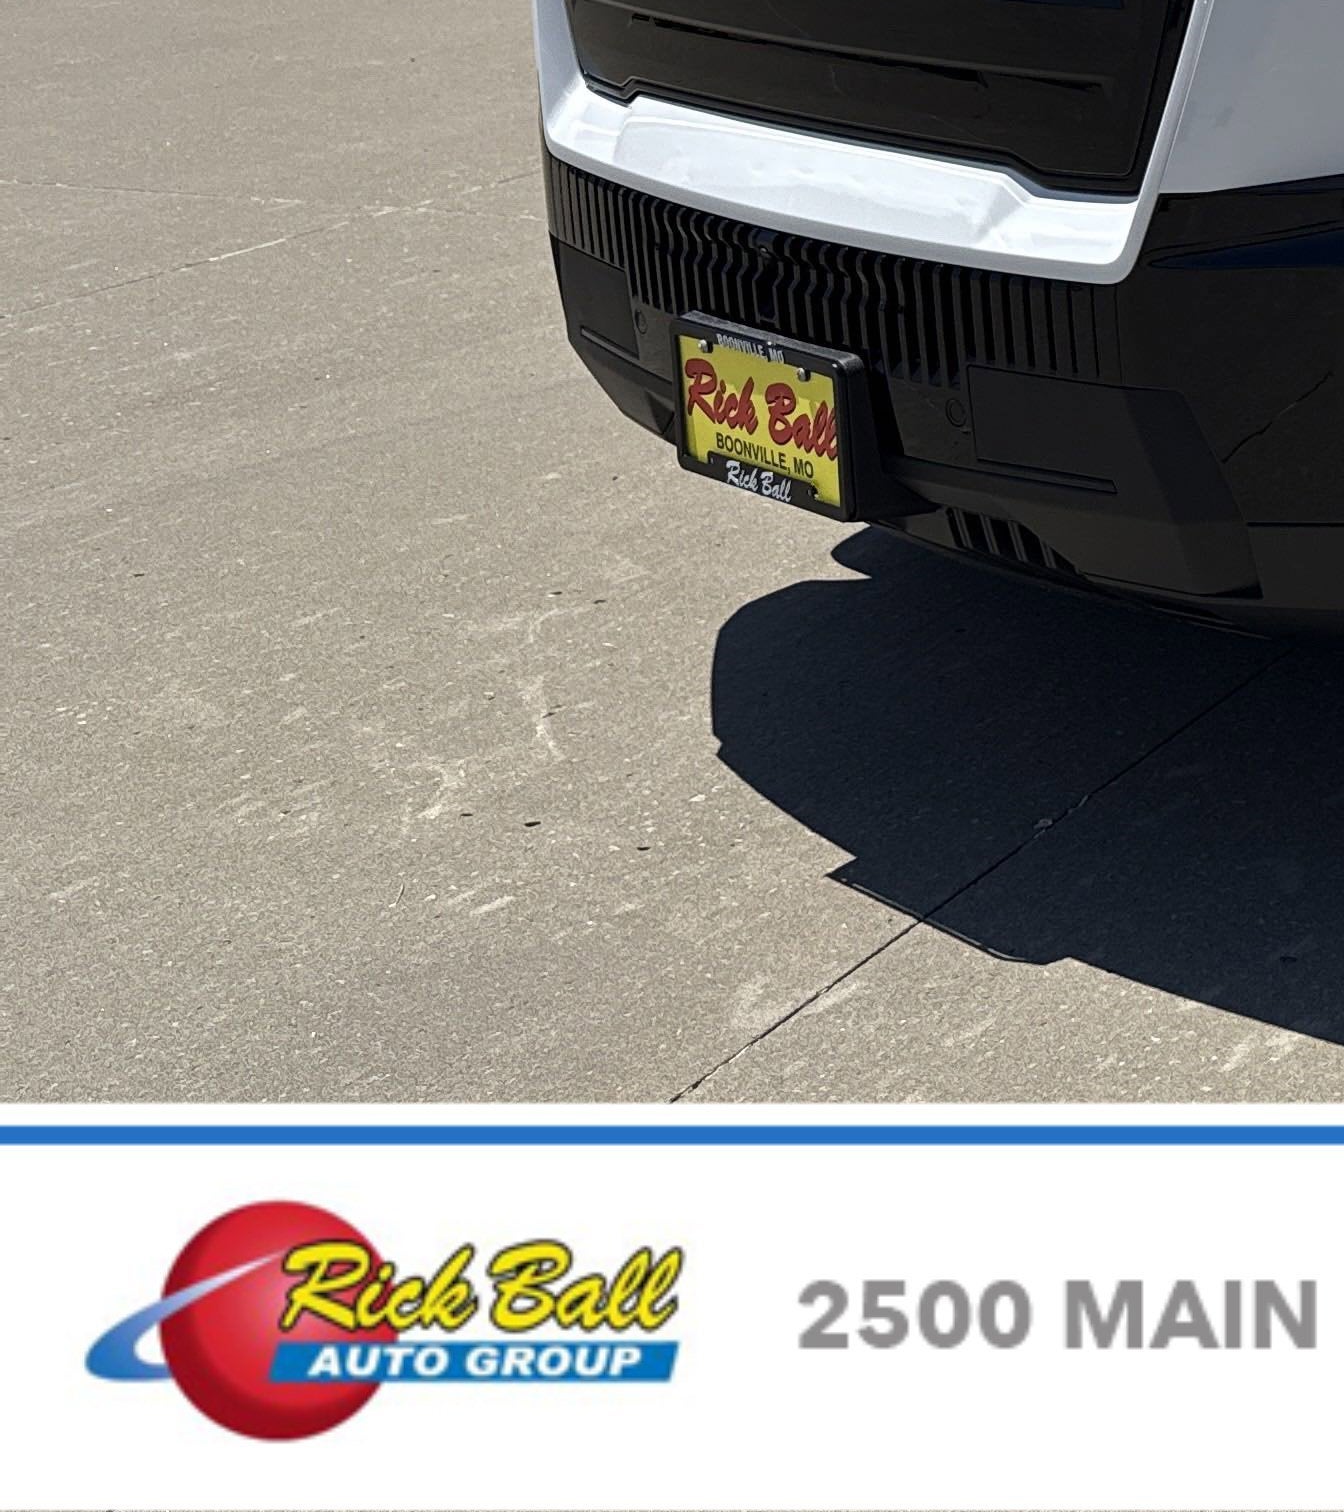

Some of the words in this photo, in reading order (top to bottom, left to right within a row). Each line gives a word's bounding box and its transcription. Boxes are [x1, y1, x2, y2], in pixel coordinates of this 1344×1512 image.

[768, 347, 785, 365] MO
[684, 357, 759, 435] Rick
[764, 382, 838, 462] Ball
[715, 432, 792, 474] BOONVILLE,
[793, 456, 814, 479] MO
[725, 459, 759, 492] Rick
[760, 471, 792, 503] Ball
